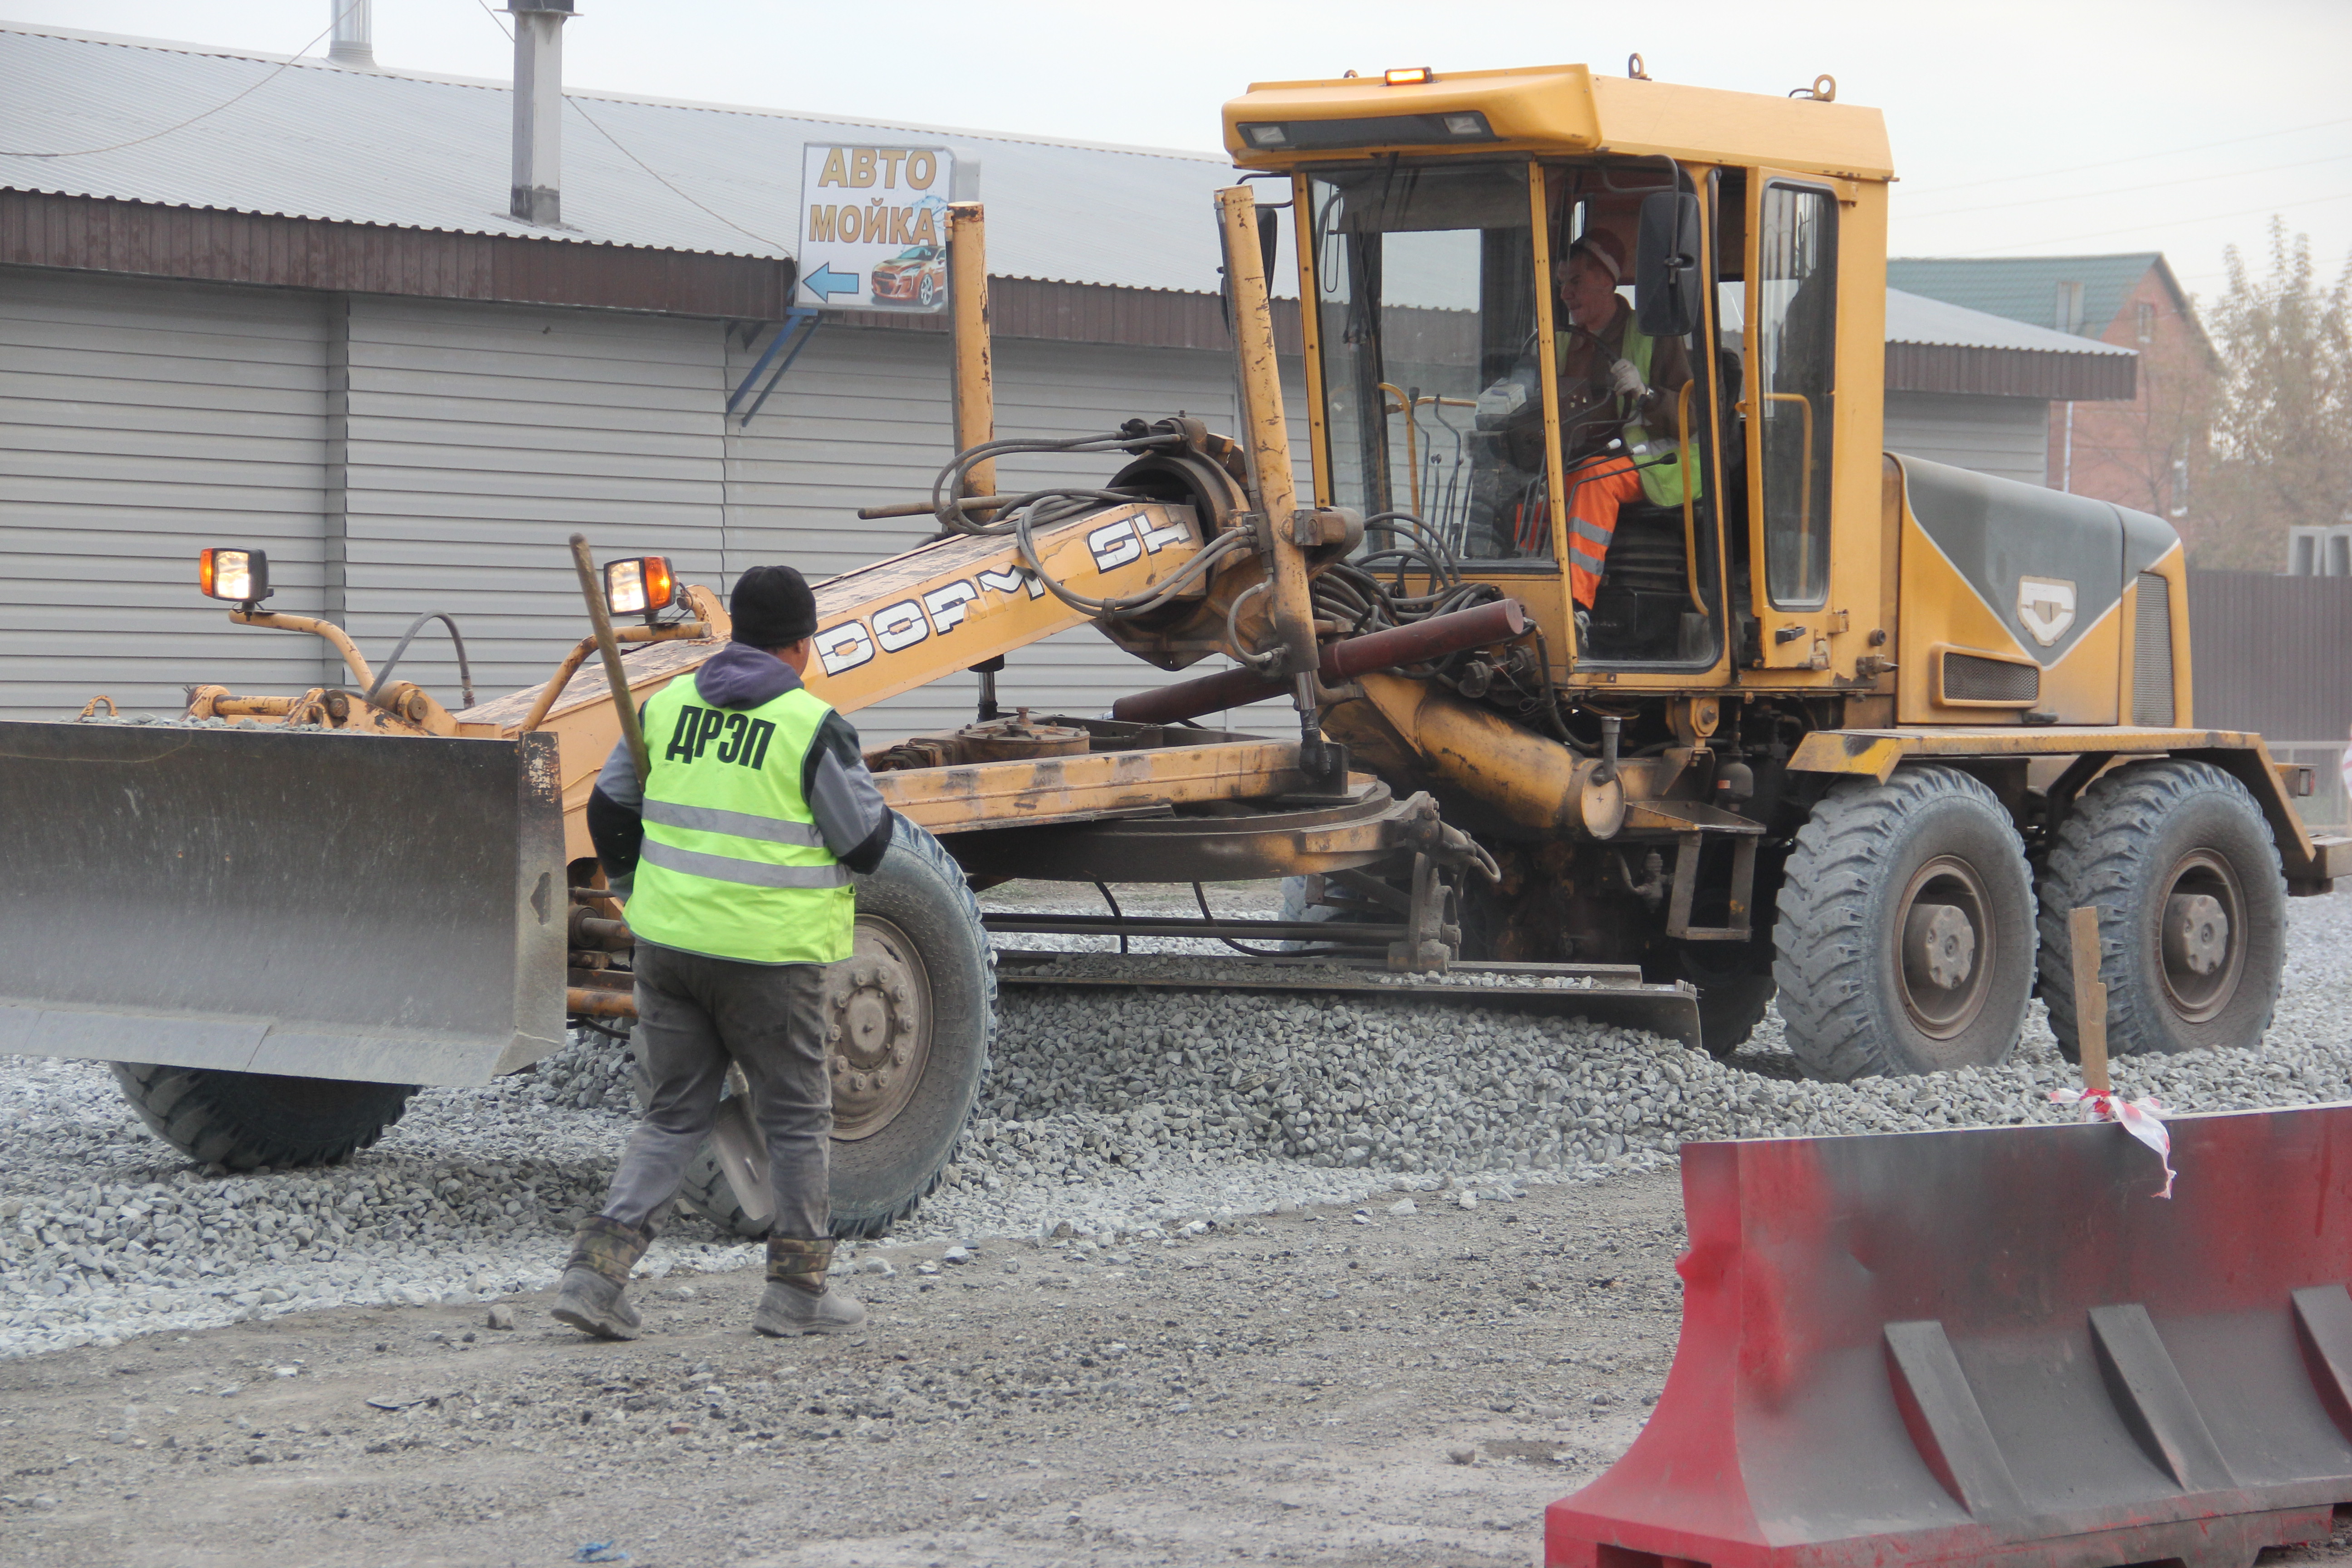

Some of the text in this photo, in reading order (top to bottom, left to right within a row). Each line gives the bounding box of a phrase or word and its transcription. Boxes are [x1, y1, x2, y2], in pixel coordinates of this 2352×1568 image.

[818, 147, 936, 190] АВТО
[809, 198, 937, 245] МОЙКА
[665, 705, 776, 770] ДРЭП
